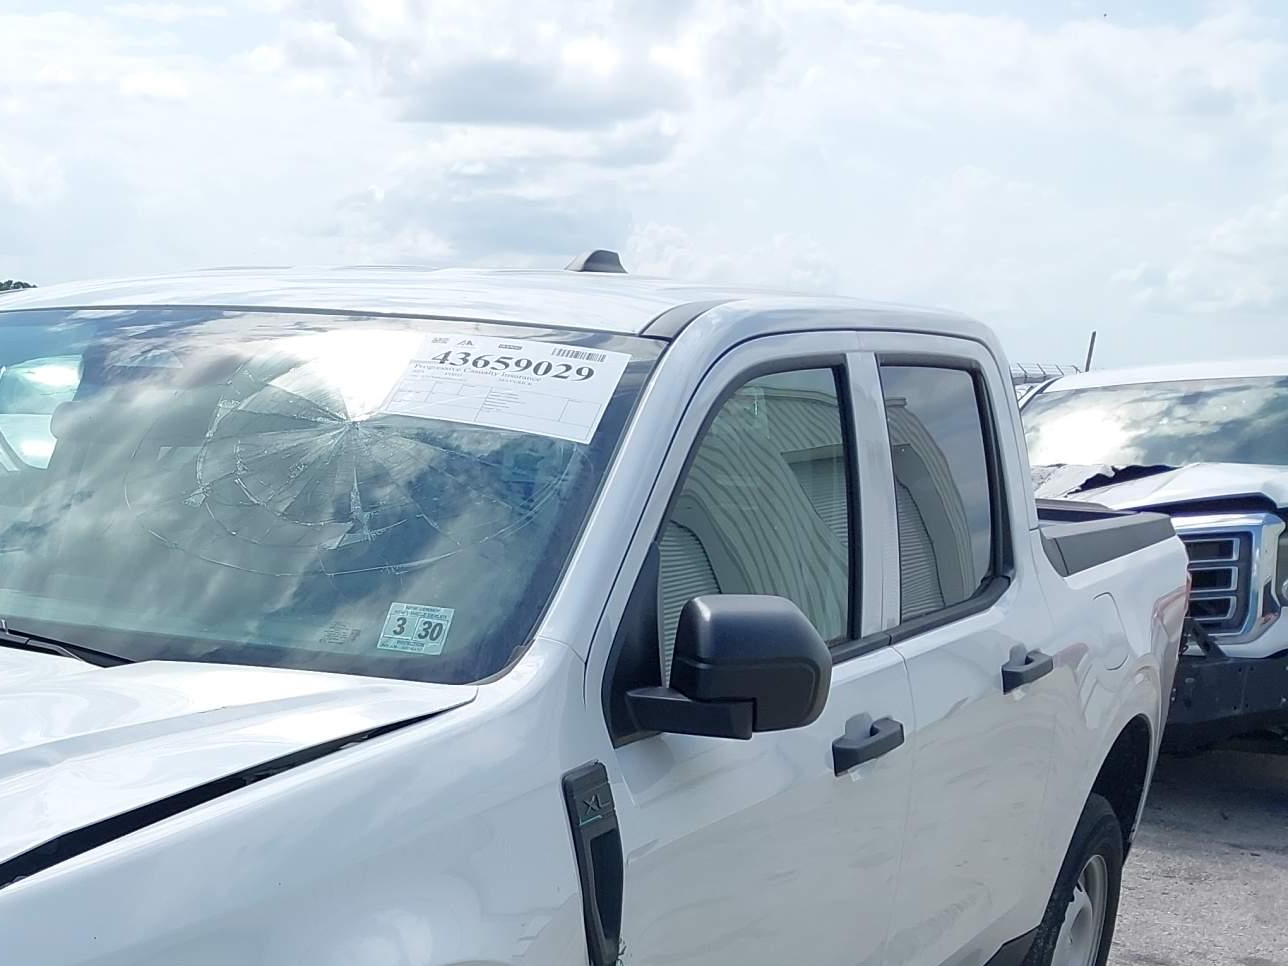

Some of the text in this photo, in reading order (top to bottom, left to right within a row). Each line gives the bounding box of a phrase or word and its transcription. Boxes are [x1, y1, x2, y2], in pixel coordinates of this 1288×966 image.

[431, 350, 595, 382] 43659029
[393, 617, 444, 641] 3 30
[583, 793, 611, 815] XL
